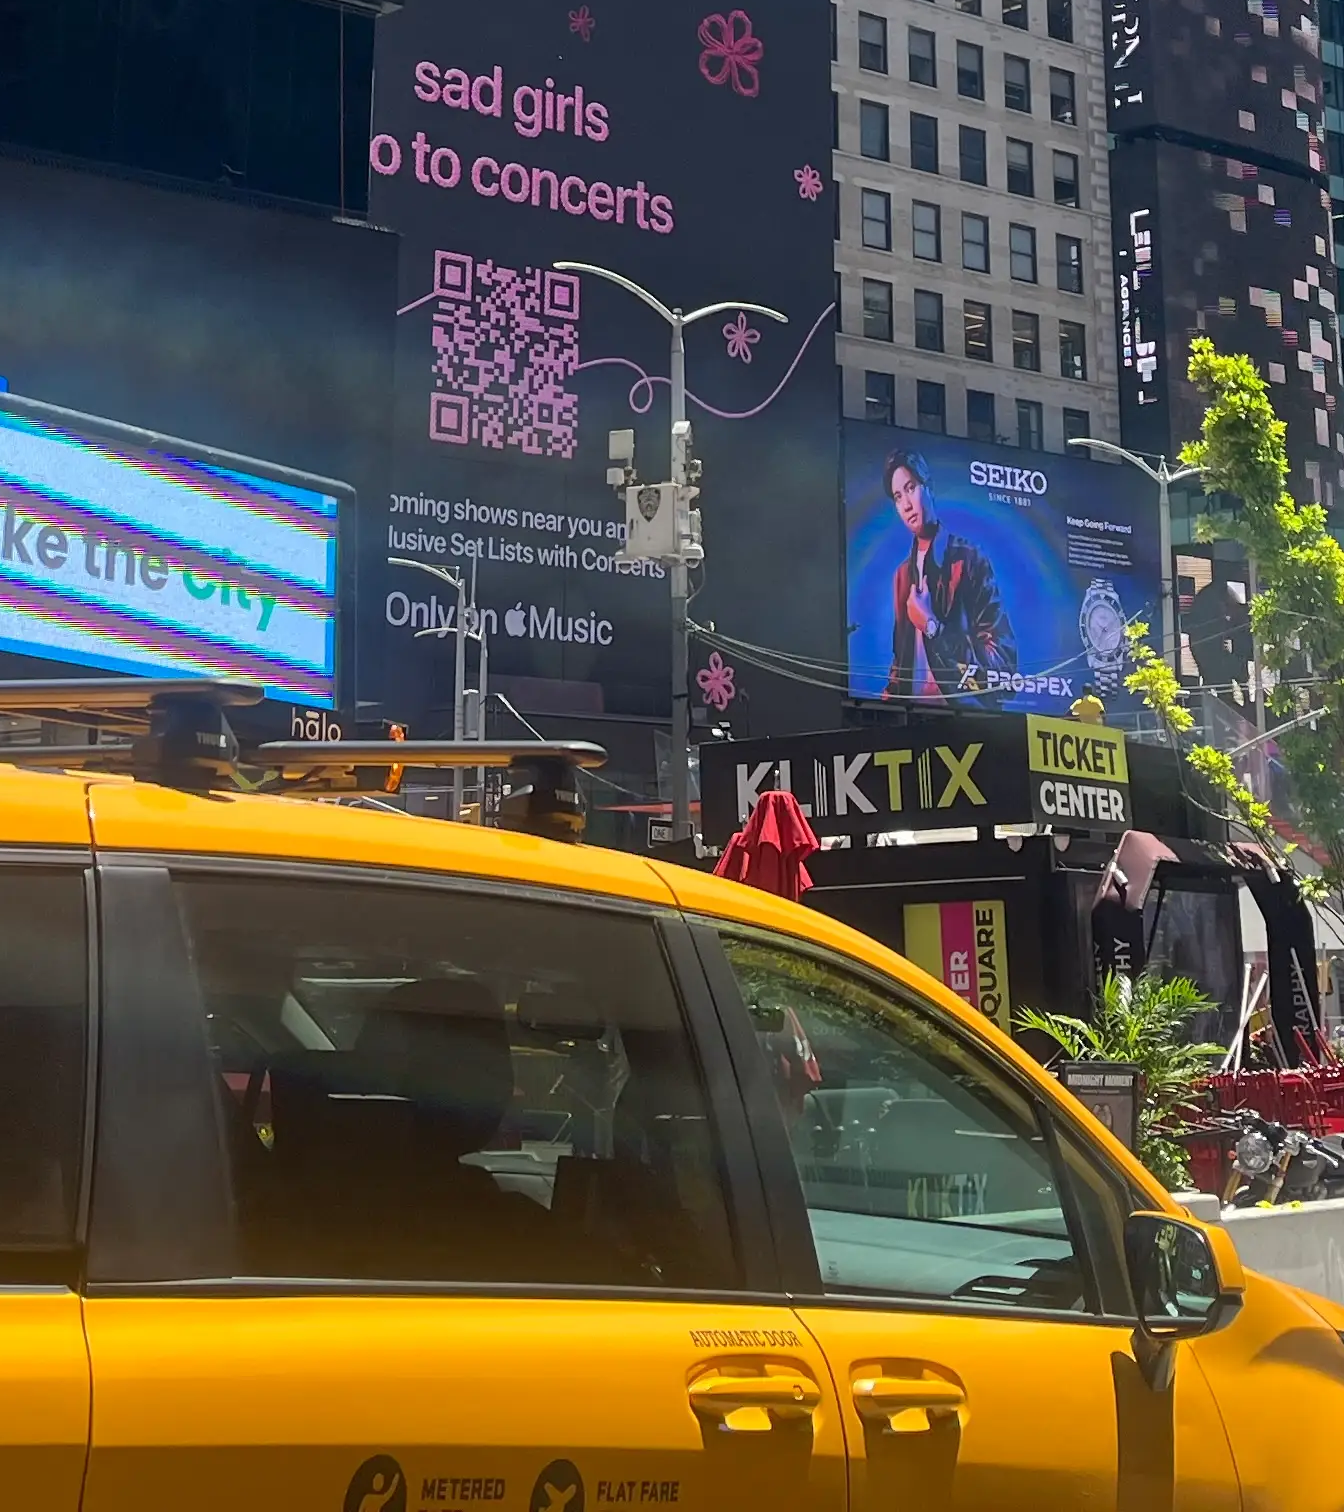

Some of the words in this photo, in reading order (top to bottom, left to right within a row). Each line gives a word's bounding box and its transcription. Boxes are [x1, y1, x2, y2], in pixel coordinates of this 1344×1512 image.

[414, 61, 503, 118] sad
[513, 78, 609, 141] girls
[370, 134, 402, 175] o
[411, 131, 462, 188] to
[471, 156, 674, 234] concerts
[970, 461, 1048, 495] SEIKO
[988, 492, 1012, 505] SINCE
[1013, 496, 1031, 507] 1881
[389, 491, 450, 525] oming
[453, 498, 518, 527] shows
[522, 510, 565, 533] near
[567, 514, 602, 539] you
[605, 522, 627, 543] an
[1066, 515, 1085, 529] Keep
[1084, 517, 1104, 531] Going
[1103, 520, 1132, 535] Forward
[83, 524, 170, 592] the
[388, 524, 446, 554] lusive
[450, 532, 484, 559] Set
[488, 537, 534, 565] Lists
[537, 543, 578, 569] with
[581, 547, 666, 579] Conerts
[385, 591, 454, 638] Only
[530, 604, 613, 646] Music
[986, 669, 1074, 698] PROSPEX
[1037, 730, 1117, 776] TICKET
[737, 742, 987, 823] KLIKTIX
[1040, 780, 1126, 823] CENTER
[1104, 1075, 1134, 1088] MOMENT
[689, 1330, 765, 1347] AUTOMATIC
[762, 1330, 803, 1348] DOOR
[420, 1477, 506, 1501] METERED
[596, 1481, 636, 1502] FLAT
[639, 1481, 680, 1503] FARE
